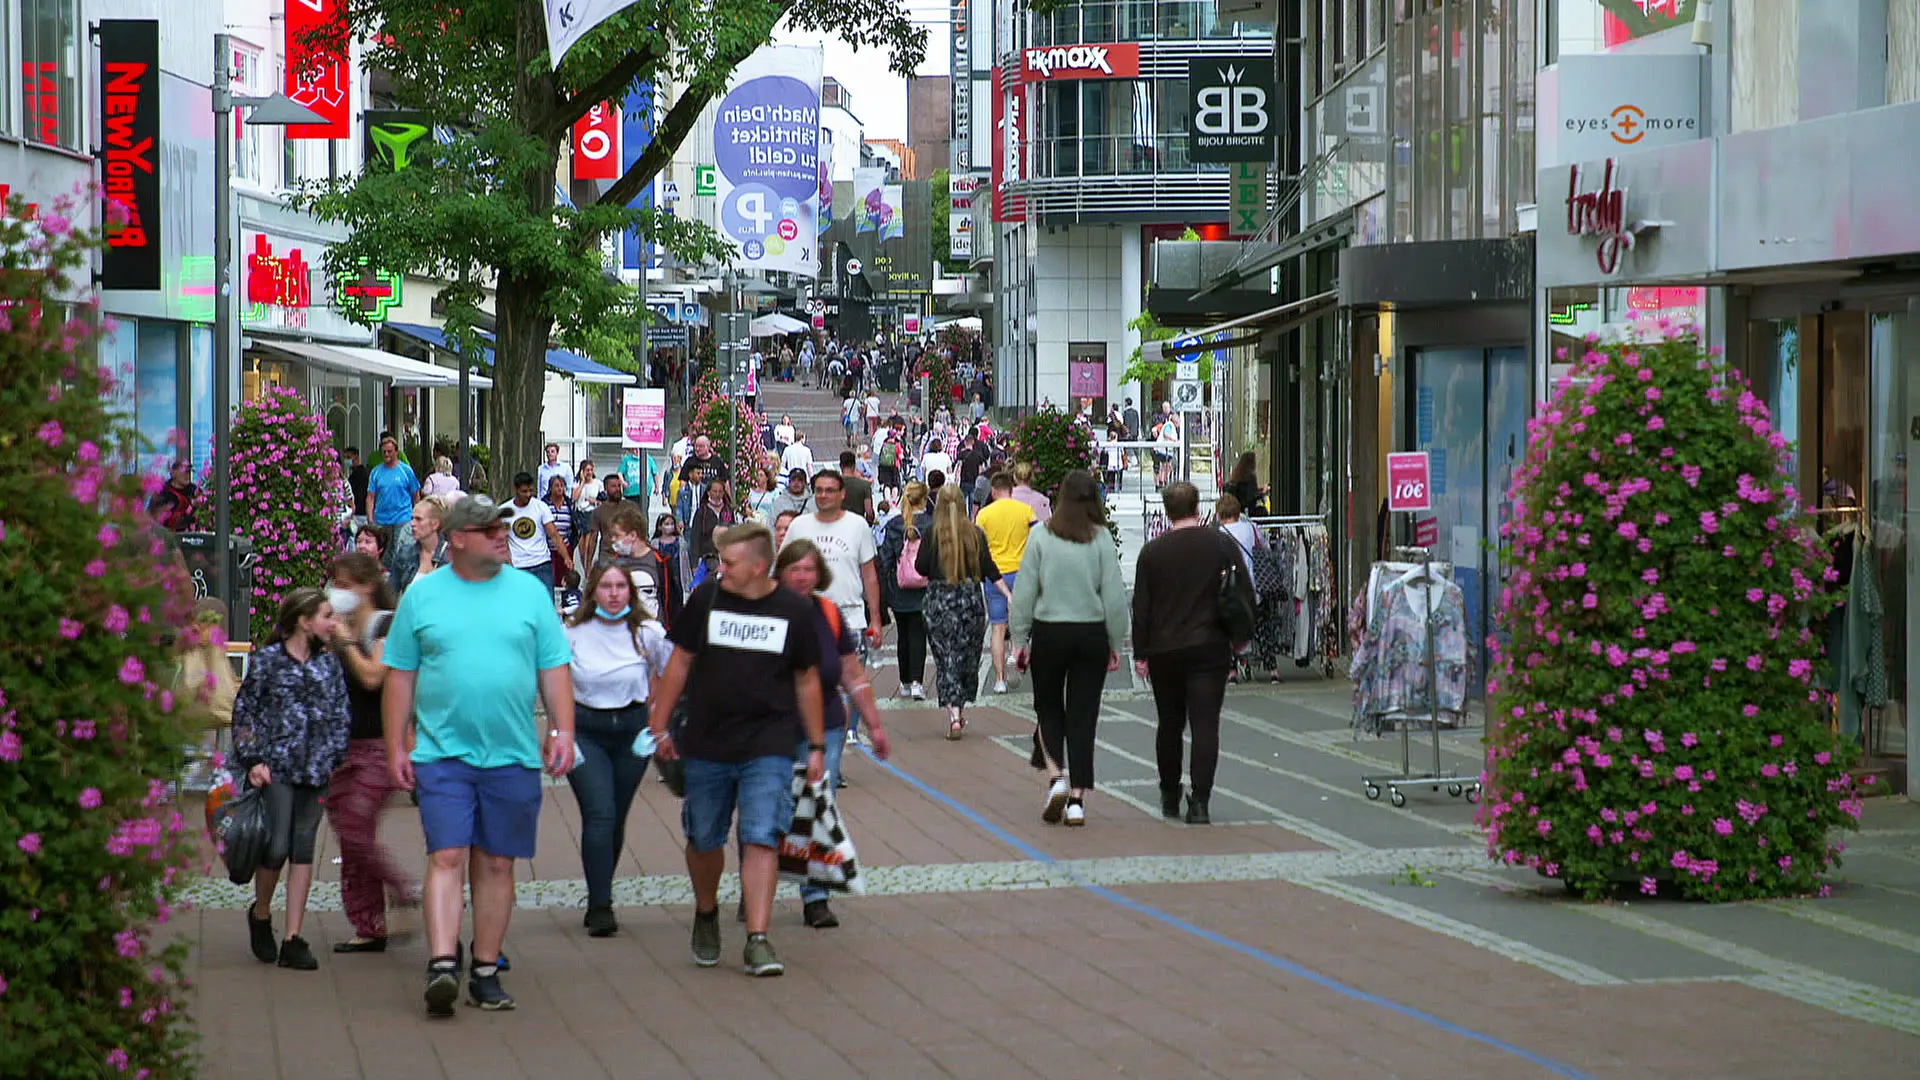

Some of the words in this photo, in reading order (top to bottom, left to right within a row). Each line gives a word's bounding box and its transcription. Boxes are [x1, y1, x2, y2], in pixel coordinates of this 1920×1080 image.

[1565, 118, 1608, 133] eyes
[1645, 119, 1695, 130] more
[1198, 136, 1224, 148] BIJOU
[1226, 136, 1265, 146] BRIGITTE
[1394, 483, 1425, 499] 10€
